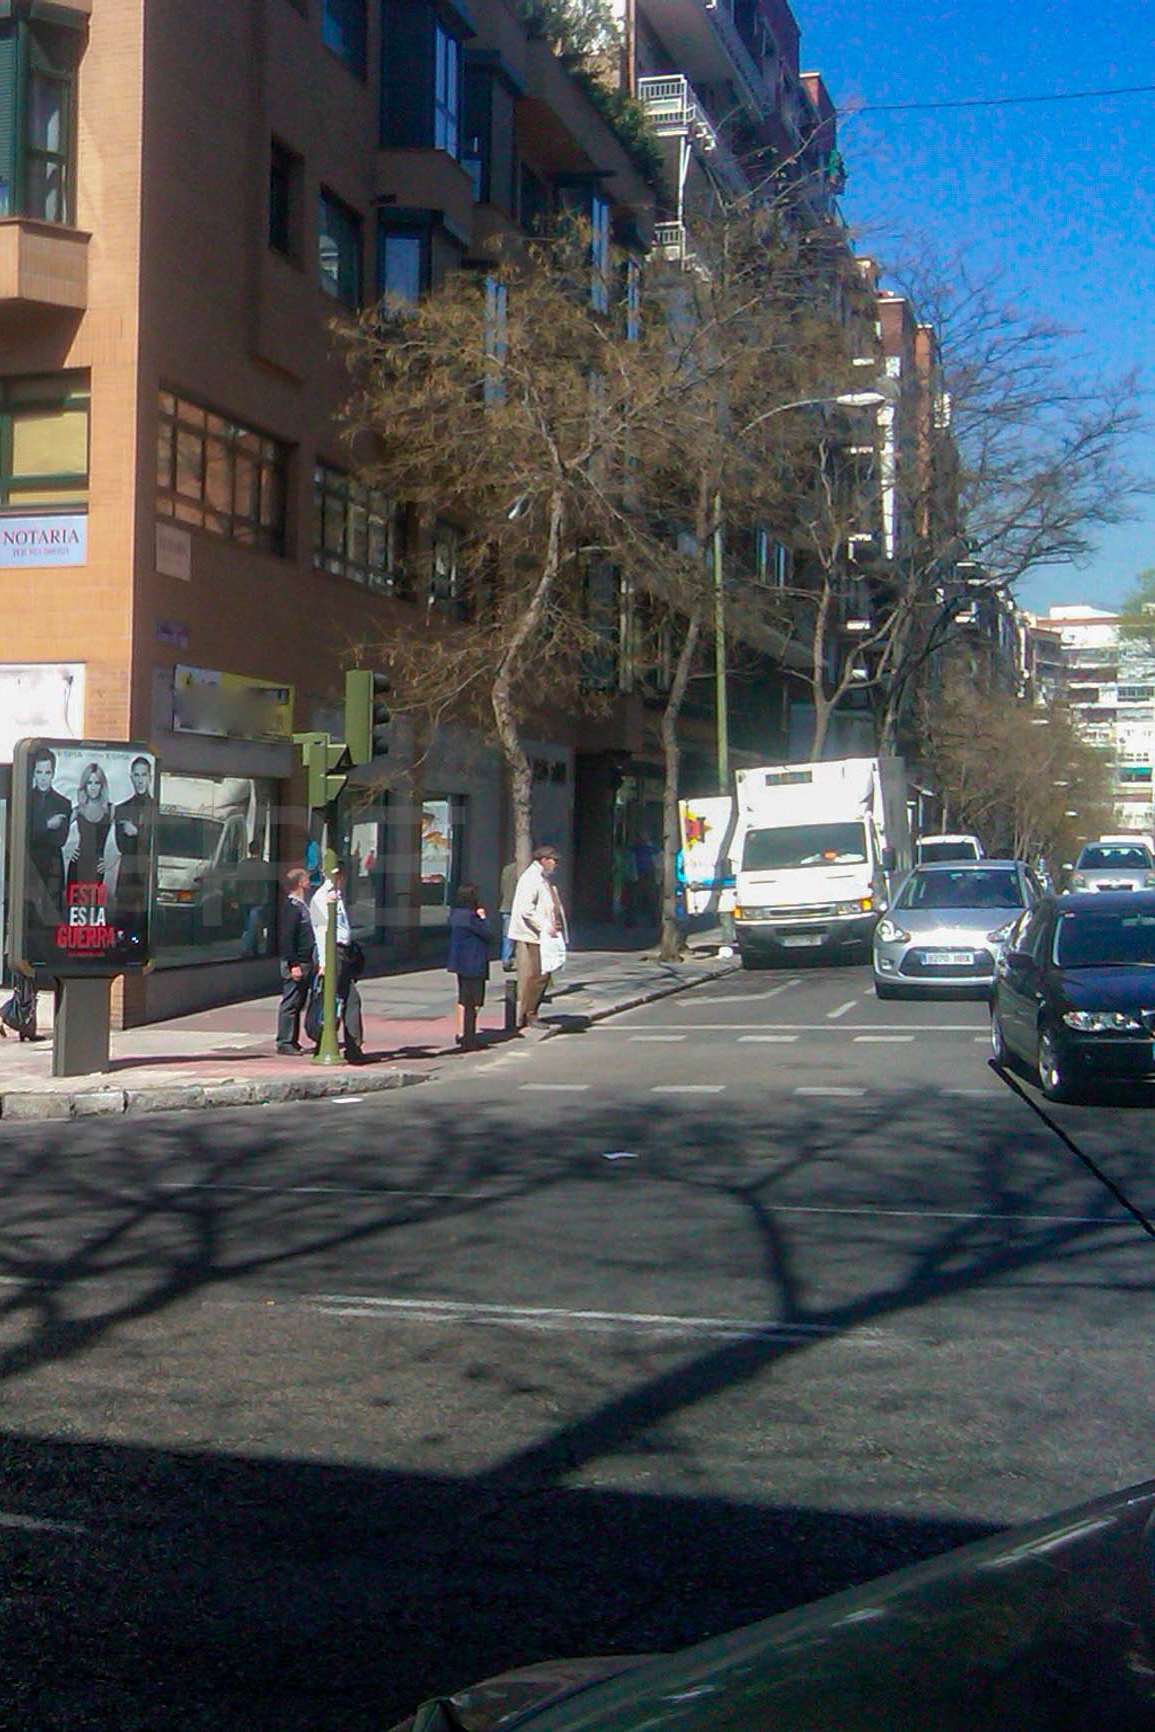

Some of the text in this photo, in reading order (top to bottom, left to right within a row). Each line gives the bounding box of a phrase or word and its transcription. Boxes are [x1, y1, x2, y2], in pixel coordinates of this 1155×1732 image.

[3, 528, 80, 545] NOTARIA
[69, 906, 107, 927] ES LA
[55, 924, 116, 949] GUERRA
